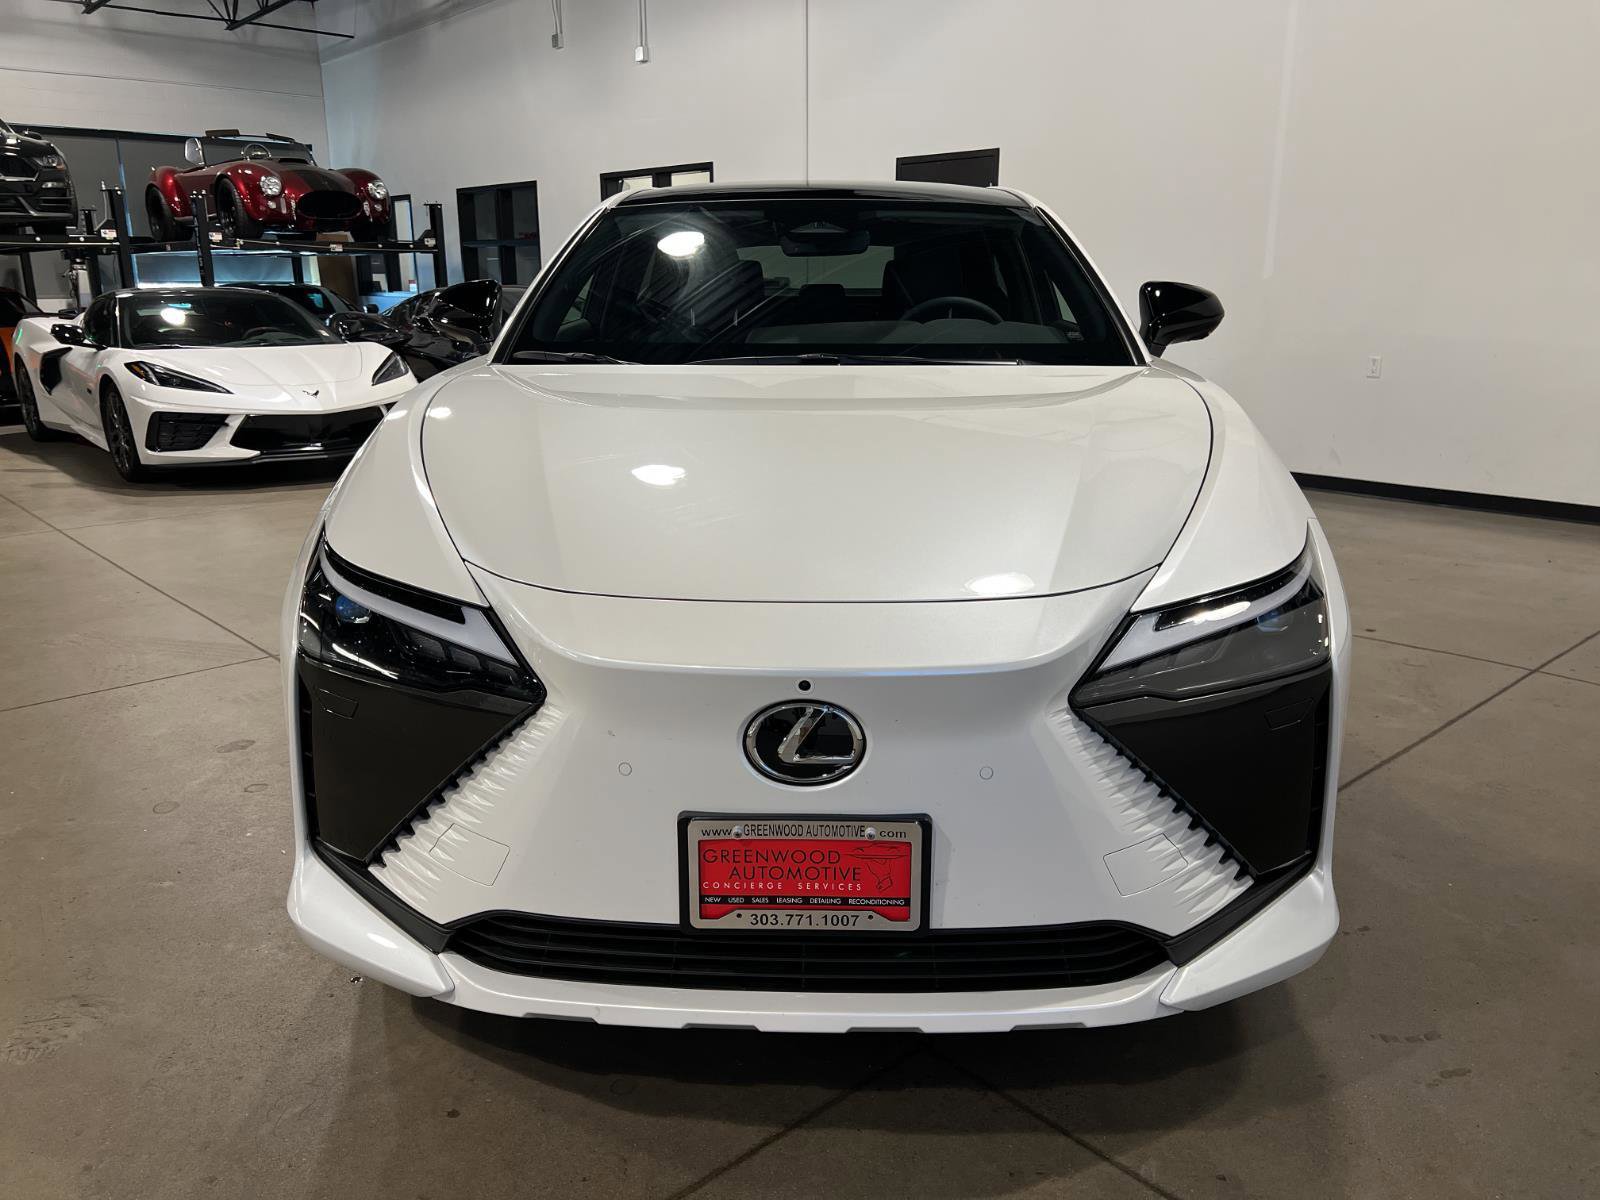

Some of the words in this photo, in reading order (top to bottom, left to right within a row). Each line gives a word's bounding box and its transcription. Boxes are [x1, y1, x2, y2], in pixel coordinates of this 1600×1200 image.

[743, 824, 804, 837] GREENWOOD
[806, 825, 866, 838] AUTOMOTIVE
[880, 830, 907, 838] com
[703, 849, 840, 865] GREENWOOD
[728, 866, 862, 881] AUTOMOTIVE
[702, 882, 783, 890] CONCIERGE
[797, 882, 862, 891] SERVICES
[809, 897, 842, 905] DETAILING
[848, 898, 905, 906] RECONDITIONING
[750, 913, 860, 927] 303.771.1007
